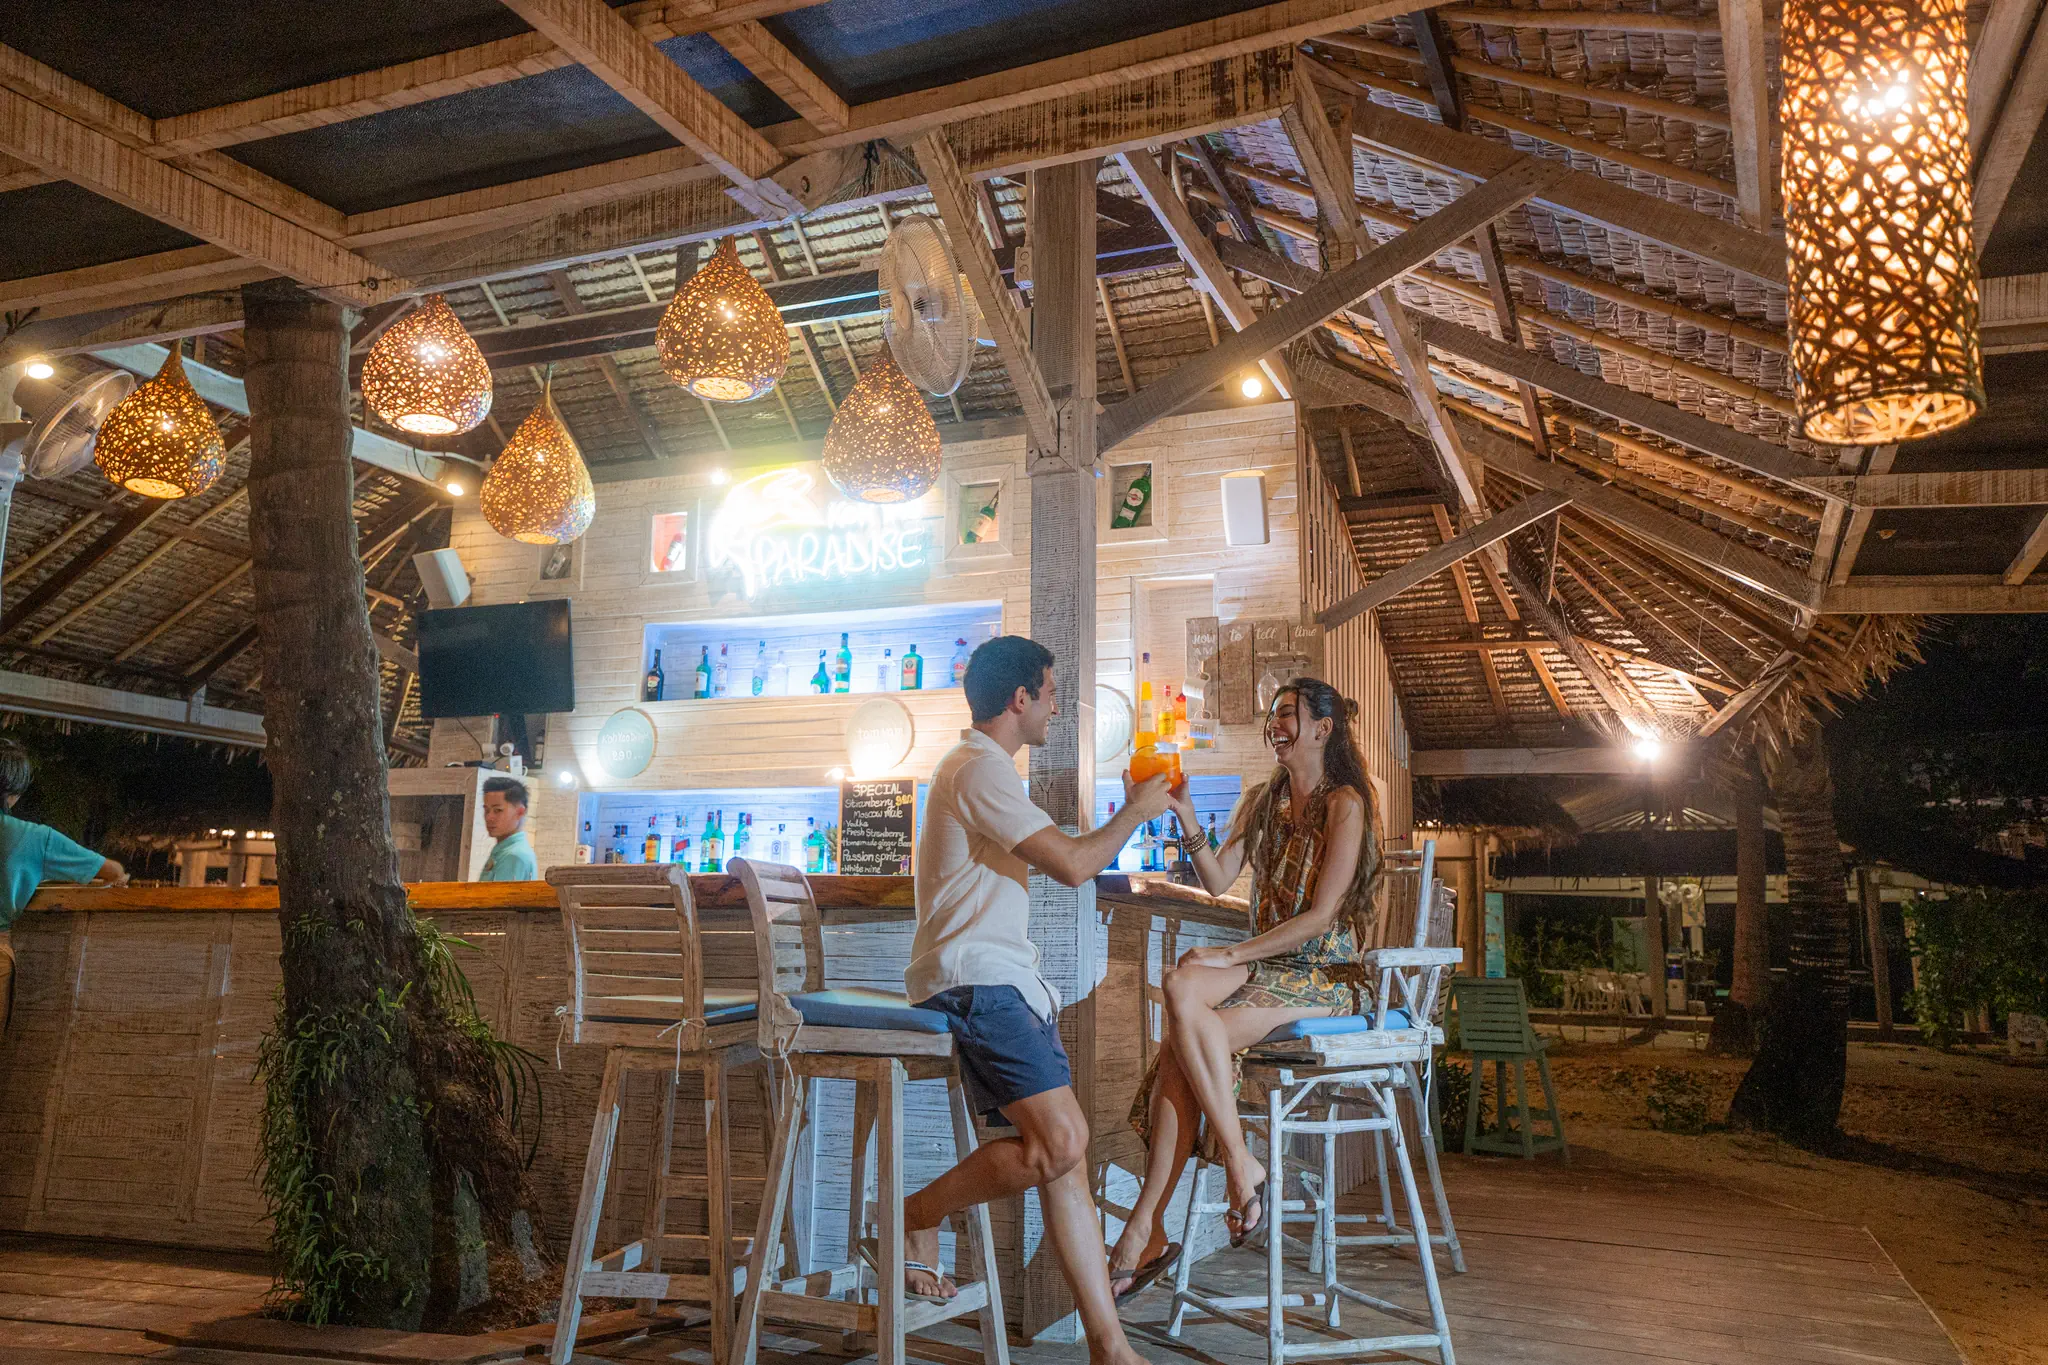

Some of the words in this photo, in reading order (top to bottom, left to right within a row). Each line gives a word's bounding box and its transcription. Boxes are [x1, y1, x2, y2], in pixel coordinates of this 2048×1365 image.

[755, 526, 925, 587] PARADISE
[1228, 628, 1244, 642] to
[1255, 627, 1278, 640] tell
[1294, 625, 1317, 638] time
[611, 749, 634, 761] 290
[852, 782, 903, 798] SPECIAL
[844, 796, 896, 811] Strawberry
[853, 809, 883, 819] Moscow
[845, 819, 869, 828] Vodka
[846, 827, 865, 836] Fresh
[877, 838, 897, 851] ginger
[843, 848, 874, 862] Passion
[844, 863, 864, 873] White
